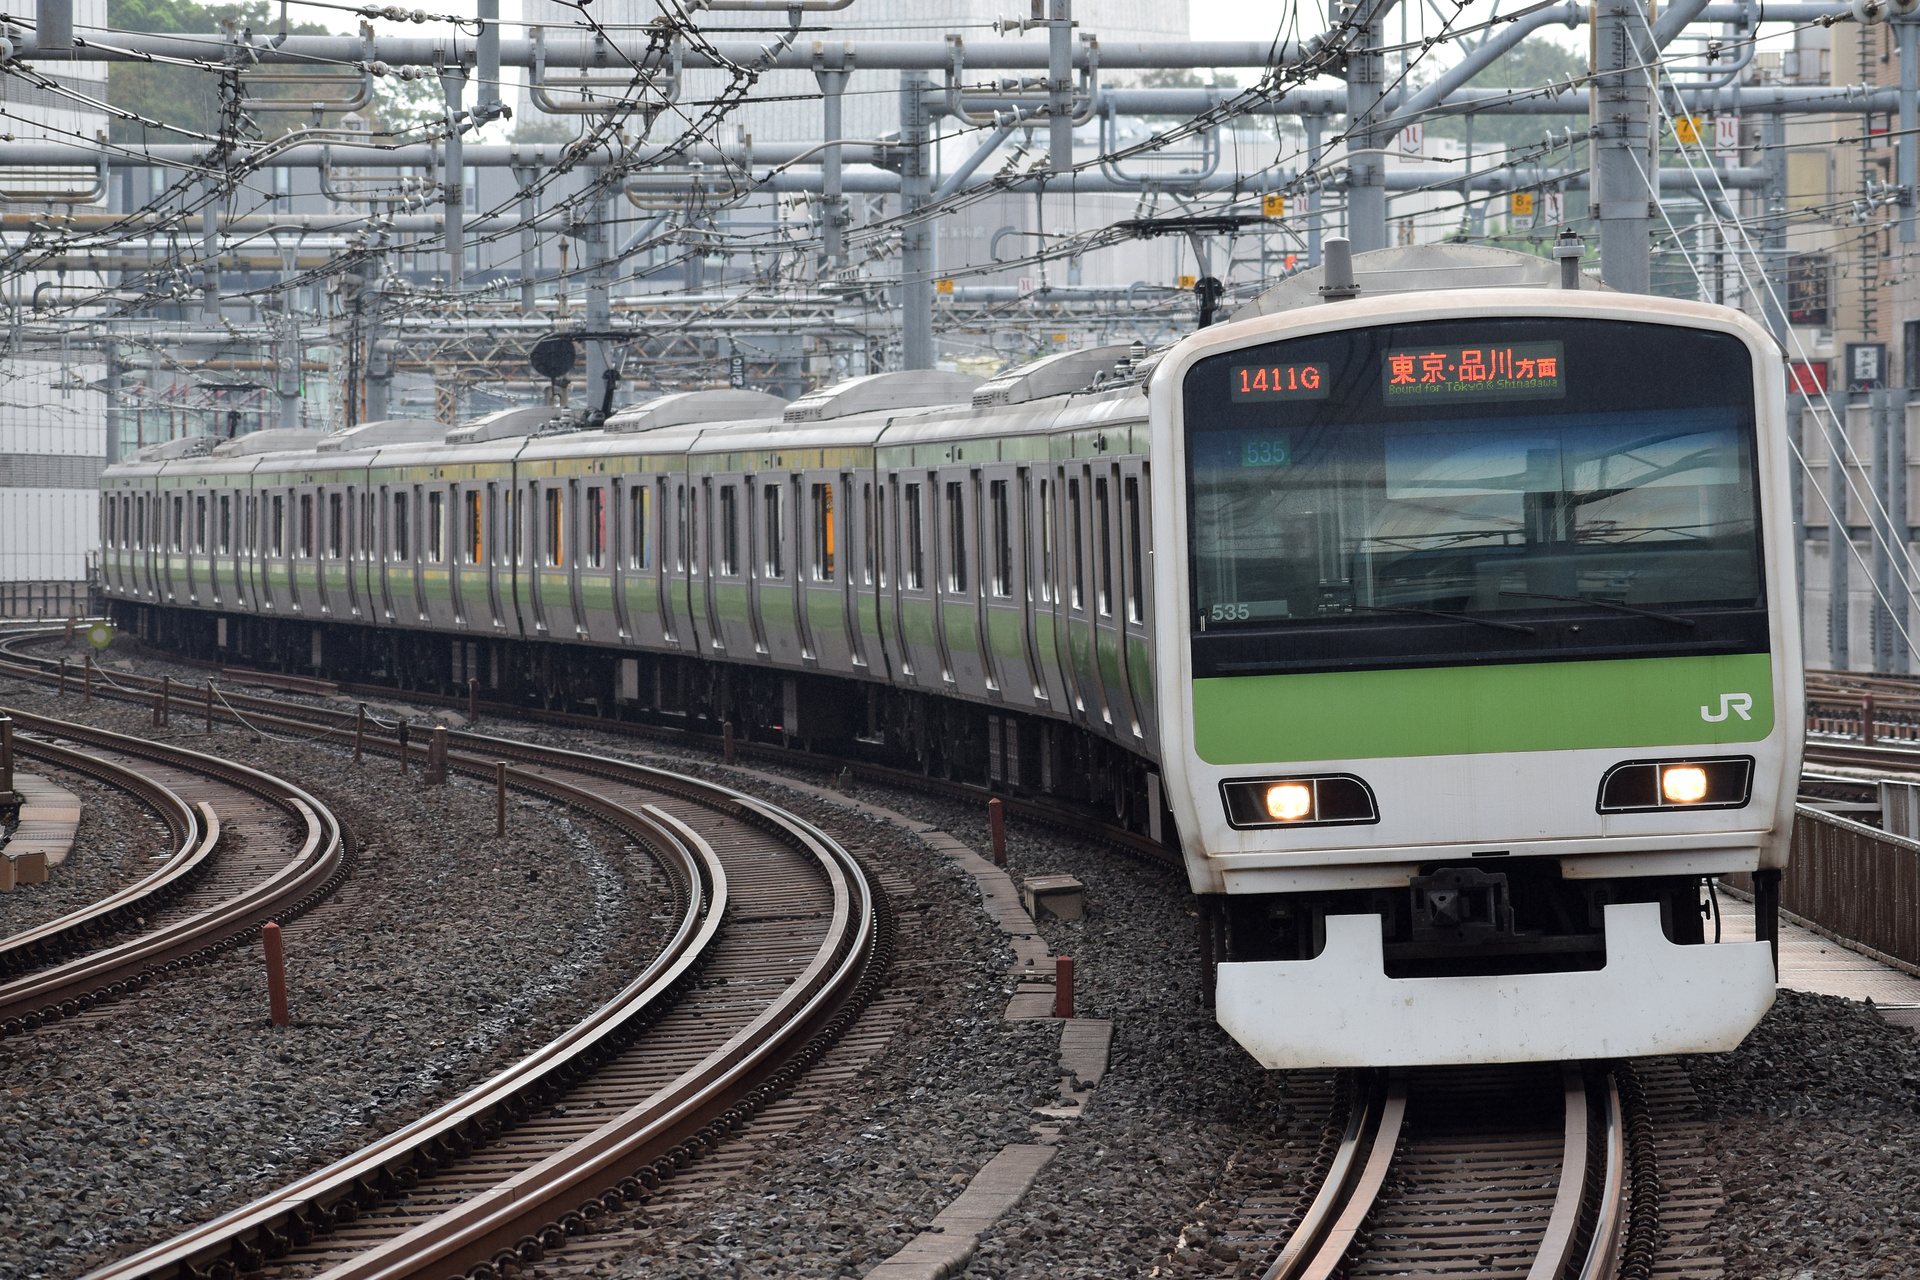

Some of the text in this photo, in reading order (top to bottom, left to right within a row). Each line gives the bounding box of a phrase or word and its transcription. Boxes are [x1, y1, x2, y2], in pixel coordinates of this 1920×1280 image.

[1516, 195, 1524, 206] 8
[1388, 348, 1557, 385] 東京・品川方面
[1240, 366, 1320, 393] 1411G
[1388, 384, 1422, 395] Bound
[1424, 382, 1442, 393] for
[1487, 380, 1494, 390] &
[1496, 379, 1558, 391] Shinagawa
[1247, 440, 1285, 464] 535
[1211, 603, 1250, 621] 535
[1701, 692, 1752, 722] JR
